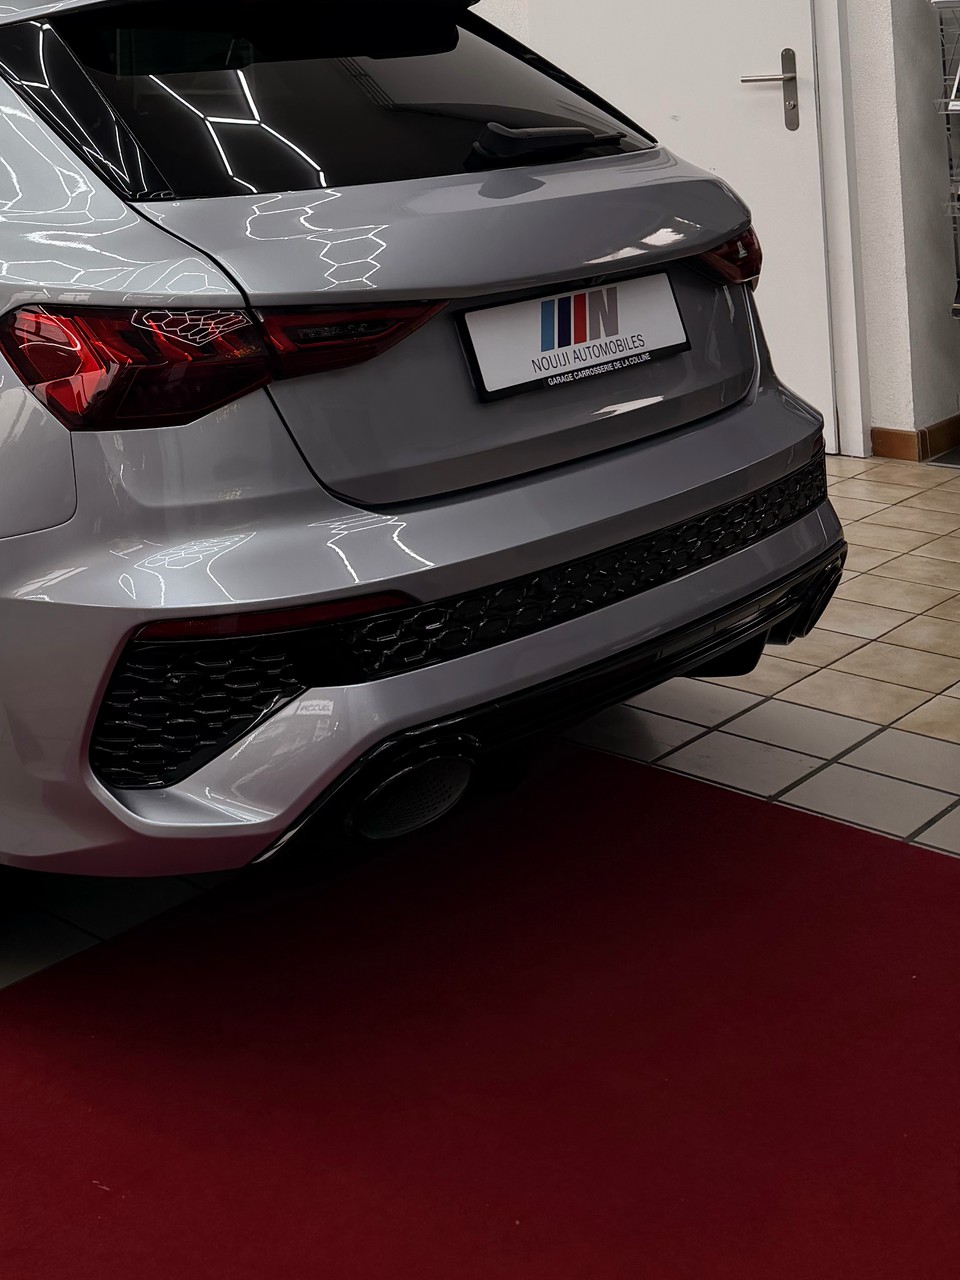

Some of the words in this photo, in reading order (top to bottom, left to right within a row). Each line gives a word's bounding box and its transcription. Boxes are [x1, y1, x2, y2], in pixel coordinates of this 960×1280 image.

[531, 351, 571, 374] NOUIJI
[572, 334, 646, 364] AUTOMOBILES
[547, 373, 574, 386] GARAGE
[573, 363, 614, 380] CARROSSERIE
[614, 361, 621, 370] DE
[620, 358, 629, 367] LA
[628, 352, 651, 365] COLLINE
